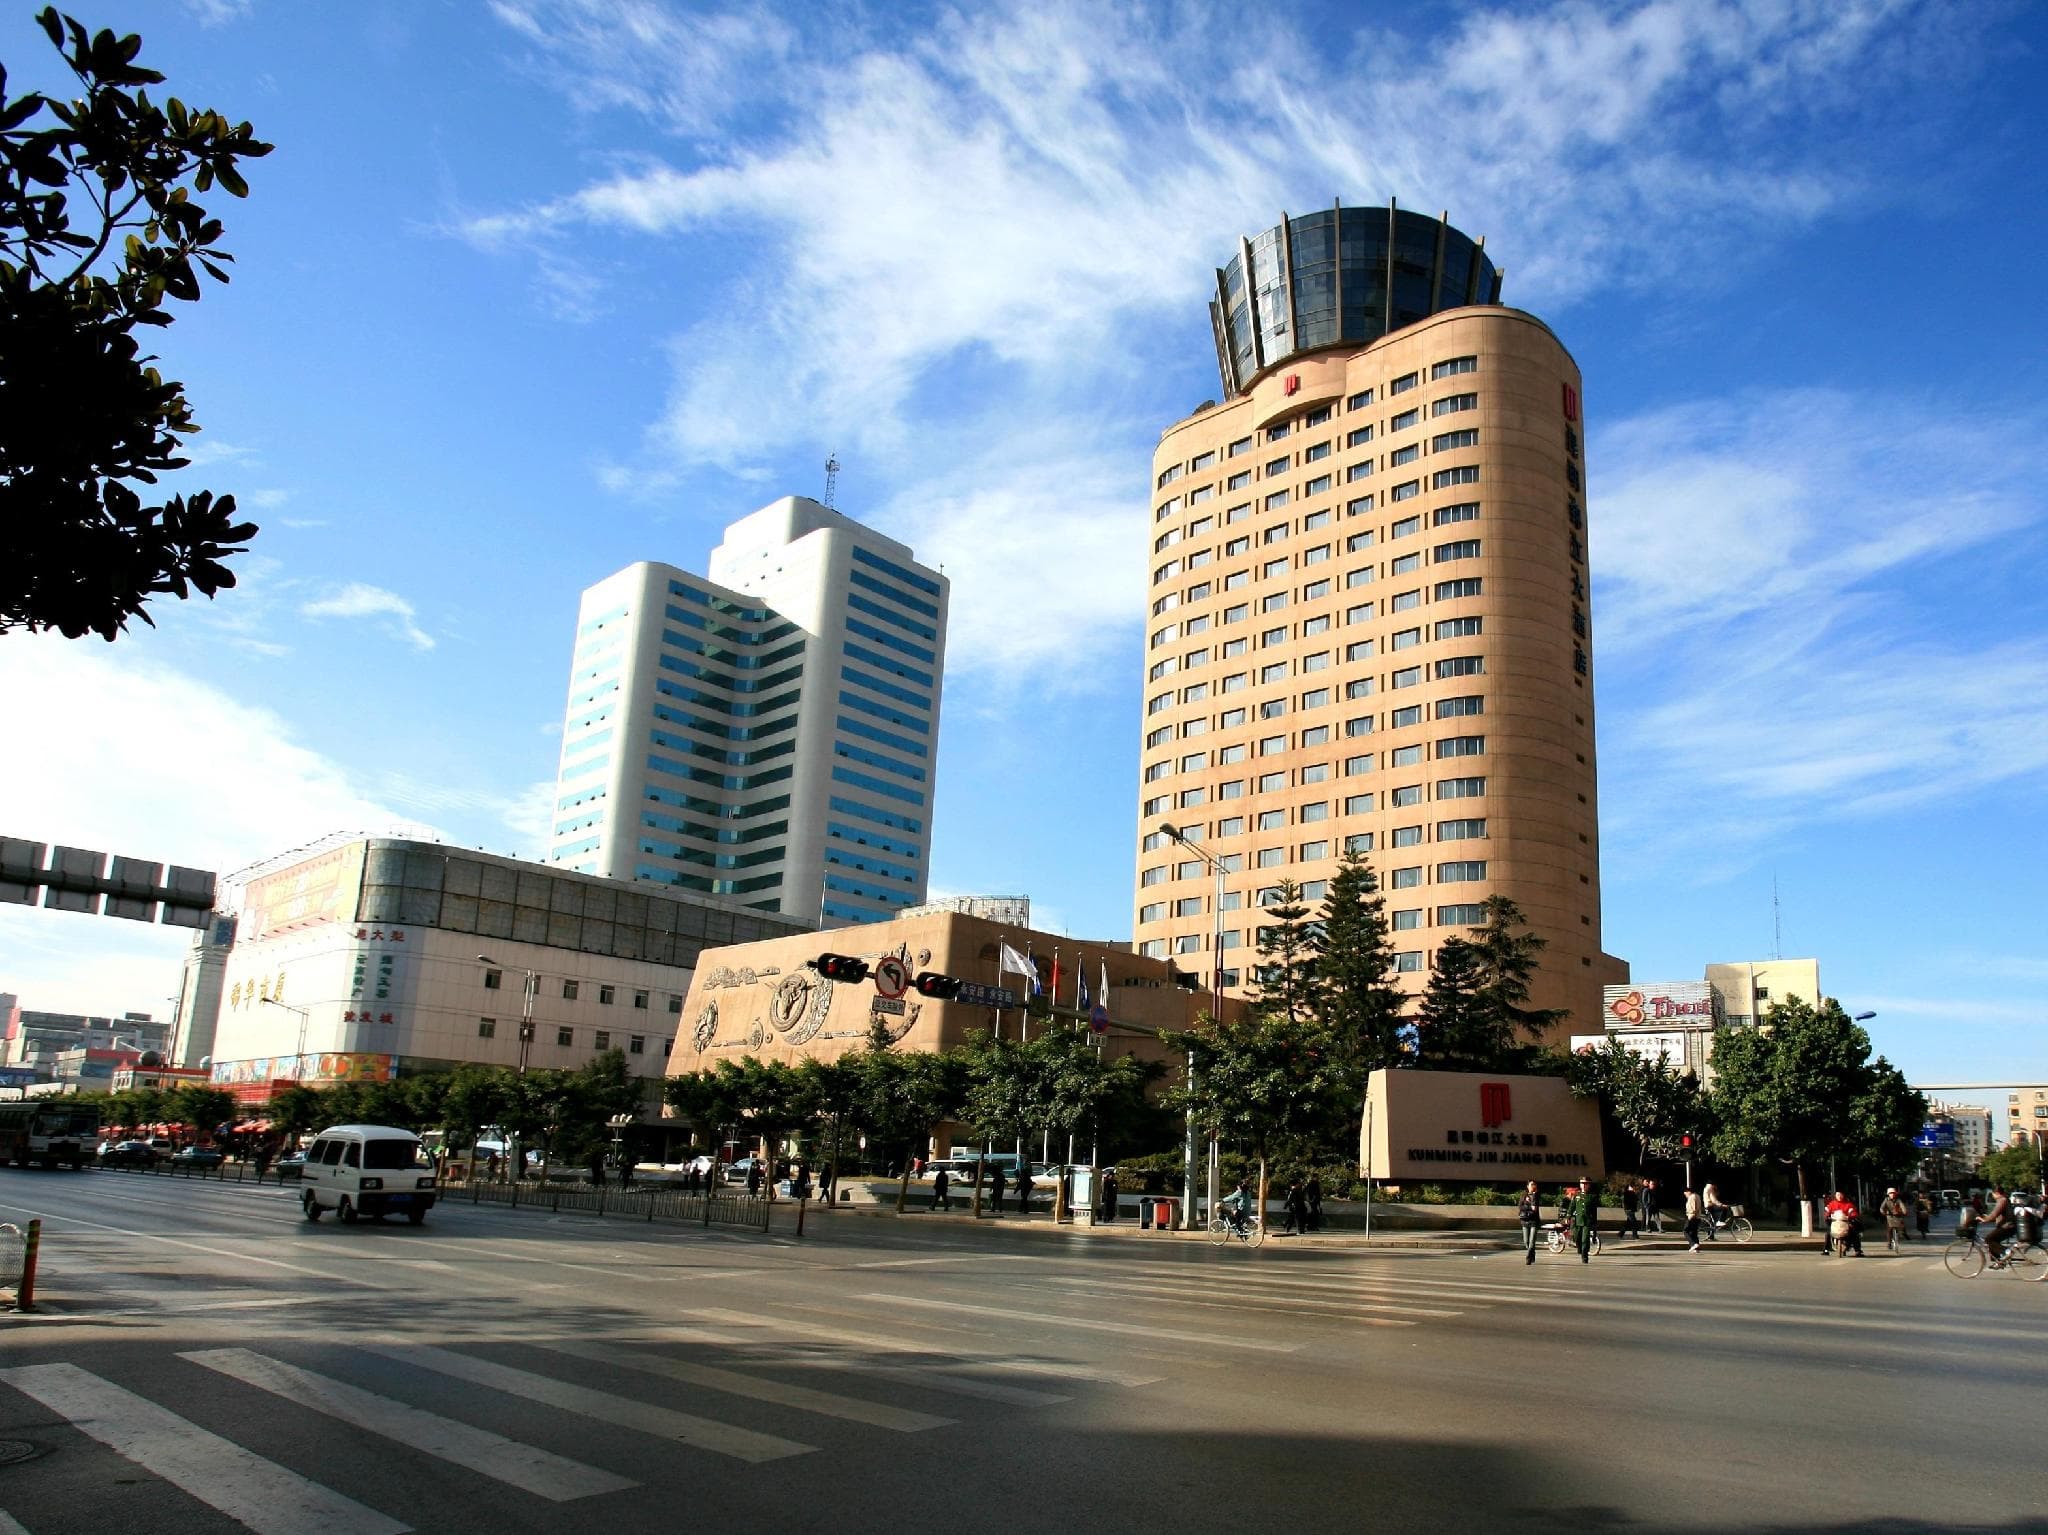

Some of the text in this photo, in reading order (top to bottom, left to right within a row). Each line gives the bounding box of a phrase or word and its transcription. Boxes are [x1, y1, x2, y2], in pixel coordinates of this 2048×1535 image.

[1408, 1149, 1588, 1166] KUNMING JIN JIANG HOTEL
